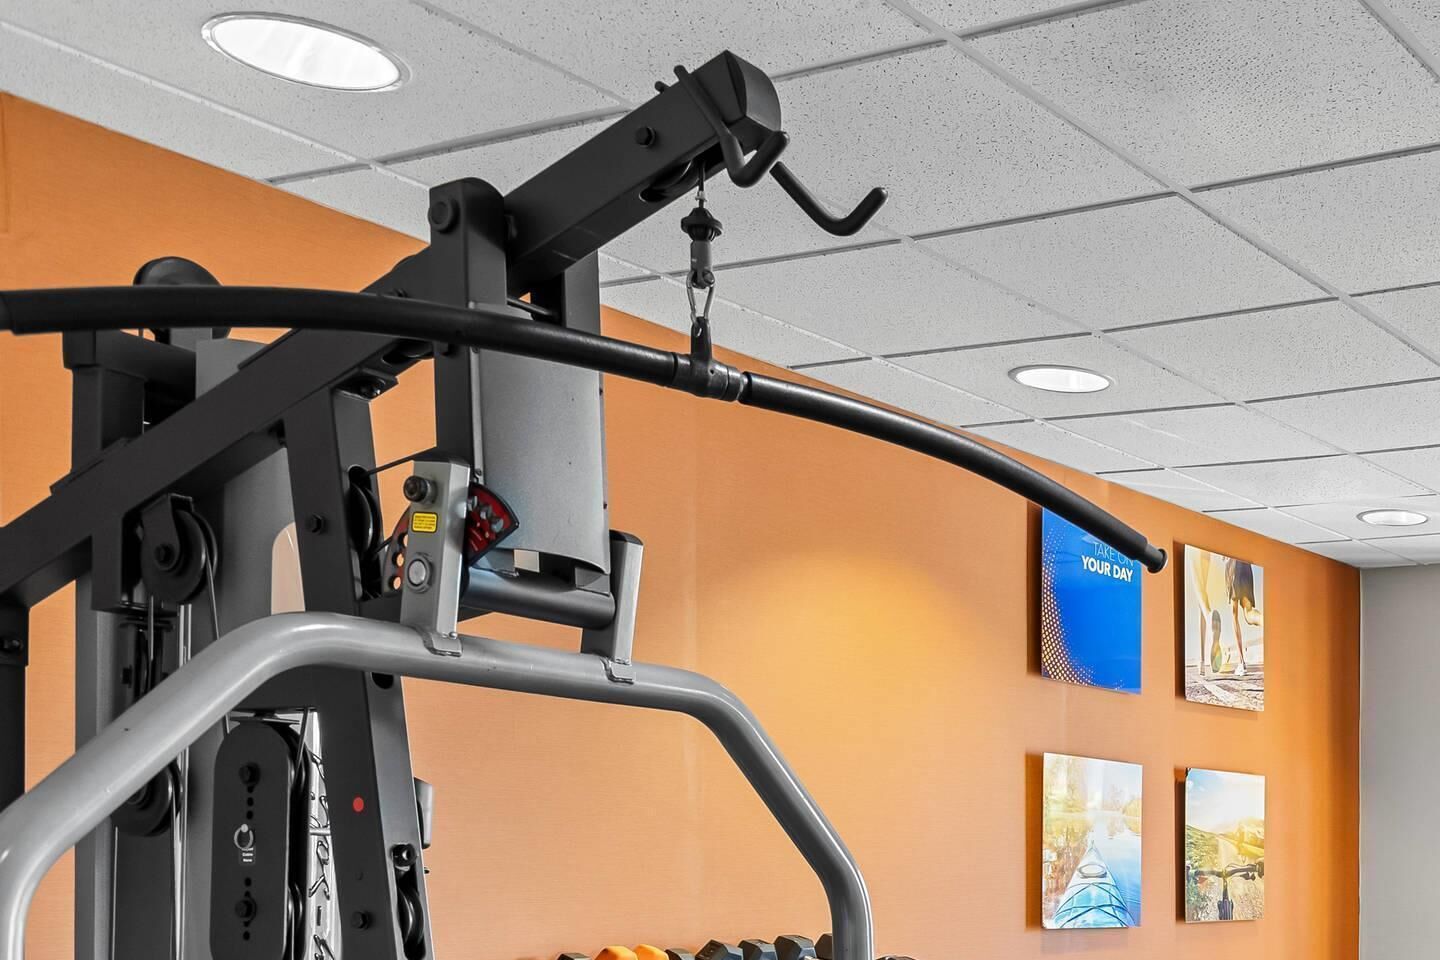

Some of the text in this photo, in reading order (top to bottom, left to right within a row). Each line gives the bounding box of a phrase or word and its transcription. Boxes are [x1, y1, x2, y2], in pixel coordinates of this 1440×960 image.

[1093, 541, 1115, 562] TAKE
[1082, 555, 1133, 582] YOUR DAY
